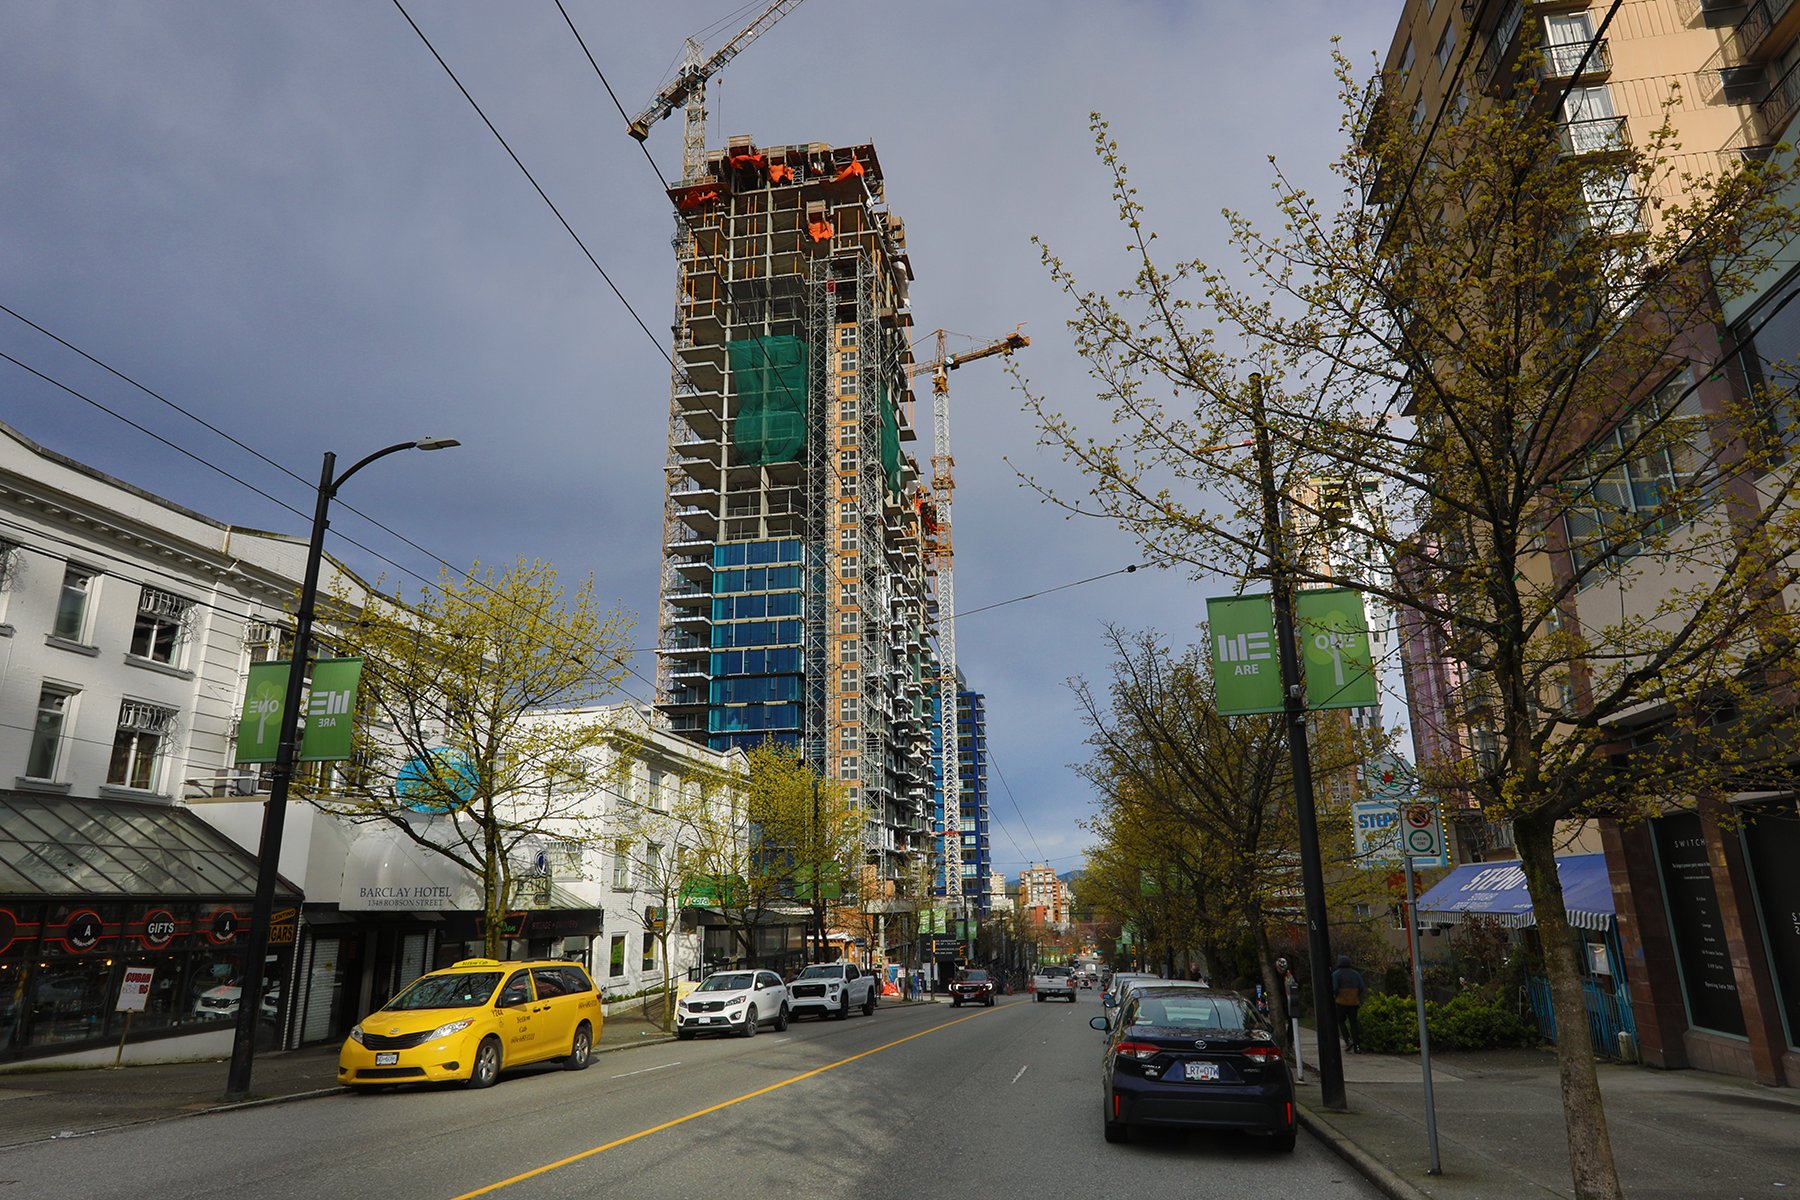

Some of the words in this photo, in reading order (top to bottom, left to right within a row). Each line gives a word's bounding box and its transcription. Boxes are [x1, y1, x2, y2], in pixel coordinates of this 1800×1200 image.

[1217, 631, 1272, 662] WE
[1314, 634, 1356, 650] ONE
[1234, 664, 1259, 676] ARE
[360, 887, 411, 898] BARCLAY
[414, 886, 452, 898] HOTEL
[148, 922, 175, 934] GIFTS
